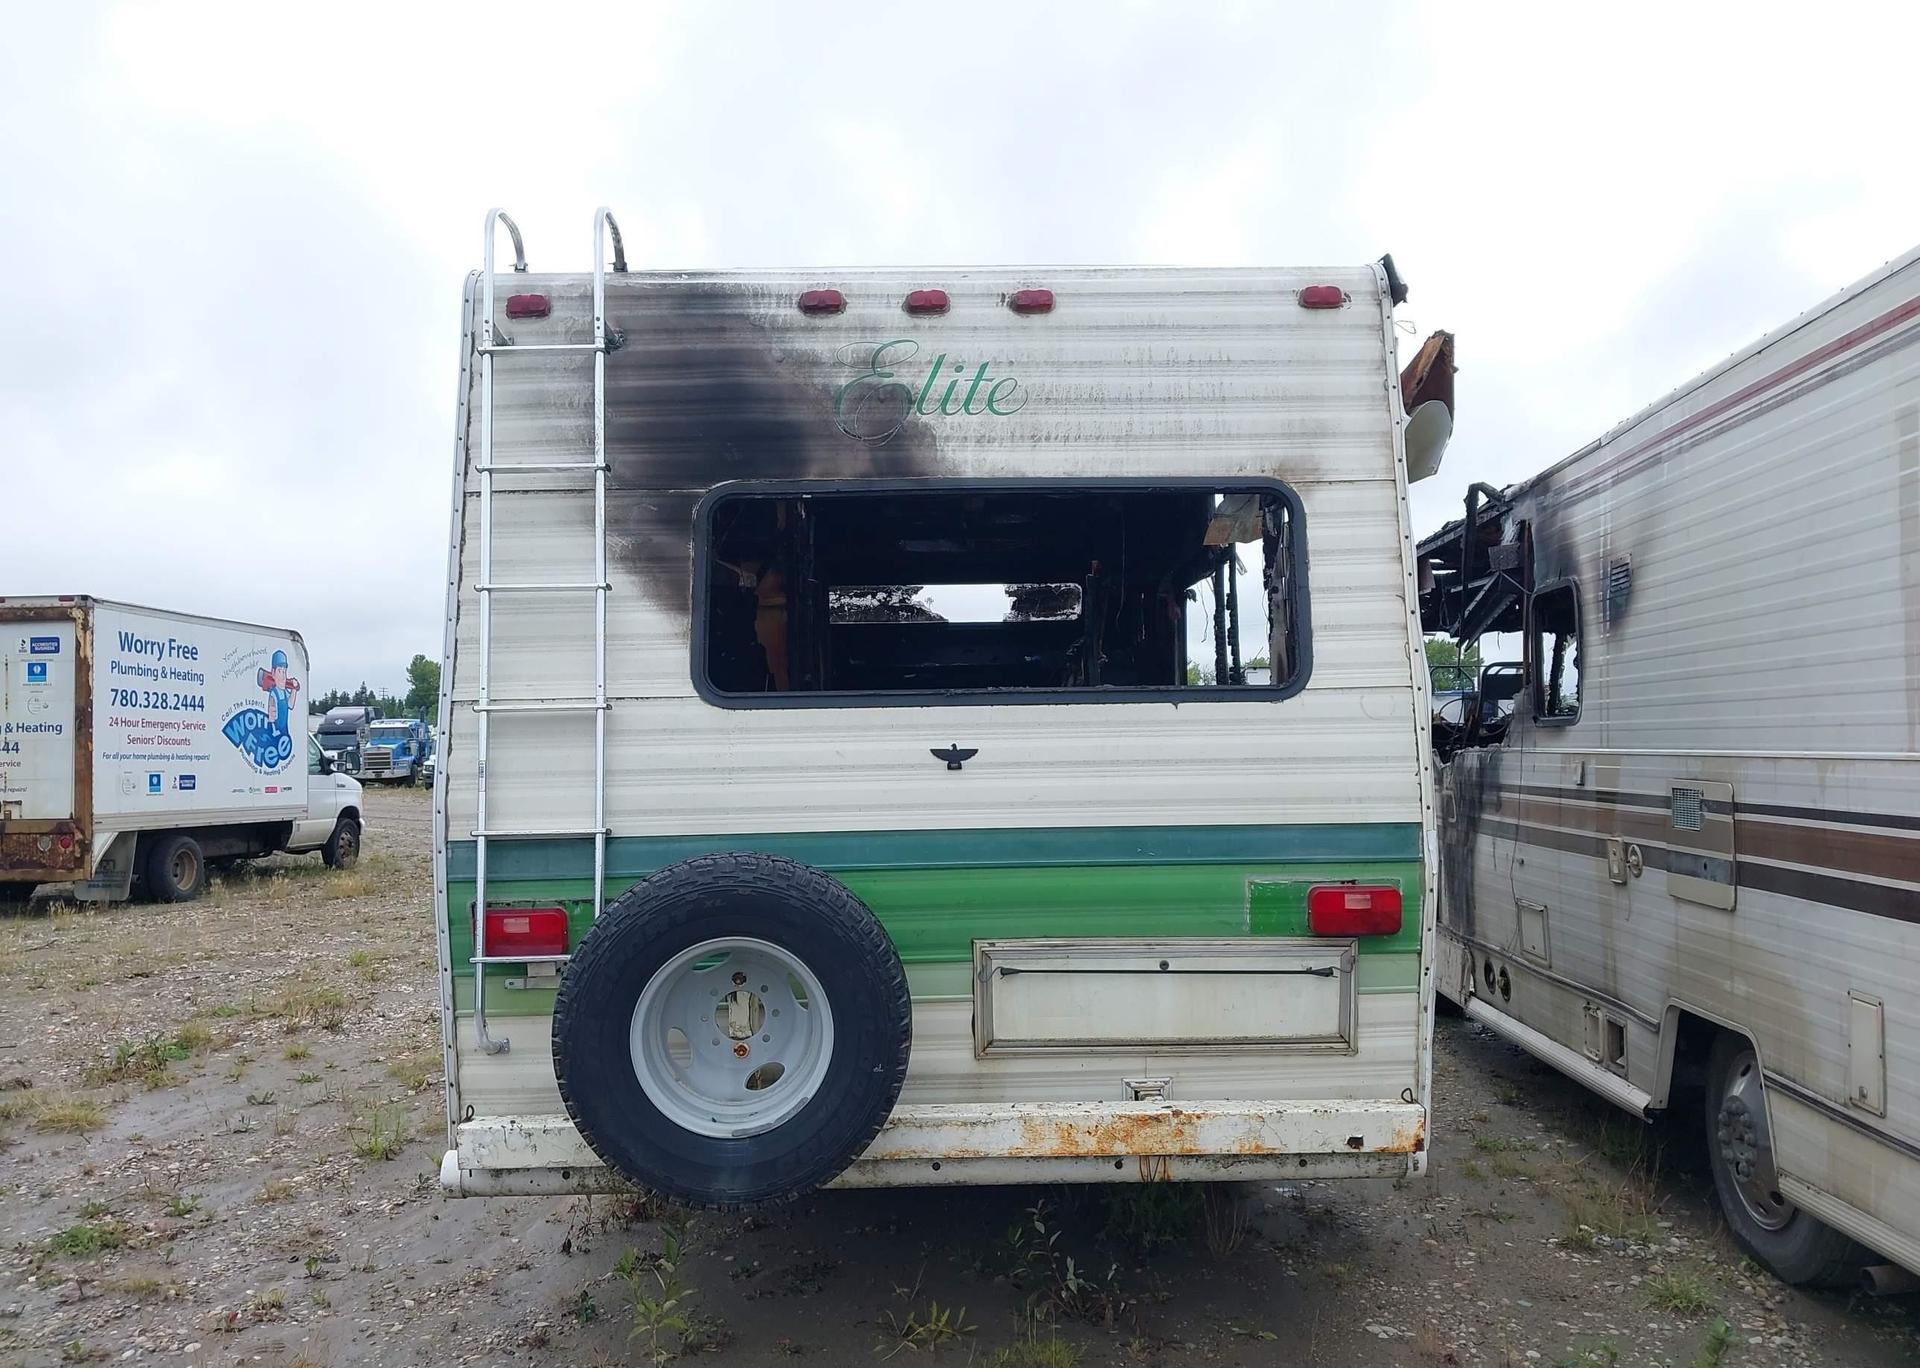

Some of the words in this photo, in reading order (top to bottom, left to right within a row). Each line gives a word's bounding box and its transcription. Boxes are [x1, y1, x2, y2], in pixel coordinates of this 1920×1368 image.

[835, 339, 1029, 447] Elite
[118, 630, 165, 661] Worry
[168, 638, 199, 661] Free
[110, 660, 159, 681] Plumbing
[160, 666, 168, 679] &
[169, 667, 204, 686] Heating
[110, 688, 205, 712] 780.328.2444
[221, 707, 233, 722] Call
[245, 698, 265, 709] Experts
[5, 722, 13, 733] &
[16, 722, 63, 735] Heating
[109, 716, 119, 727] 24
[120, 717, 140, 728] Hour
[141, 718, 180, 731] Emergency
[182, 720, 206, 731] Service
[157, 735, 191, 746] Discounts
[244, 732, 292, 765] Free
[102, 752, 112, 760] For
[112, 752, 120, 760] all
[120, 753, 133, 761] your
[147, 753, 171, 762] plumbing
[175, 753, 193, 762] heating
[193, 754, 210, 762] repairs!
